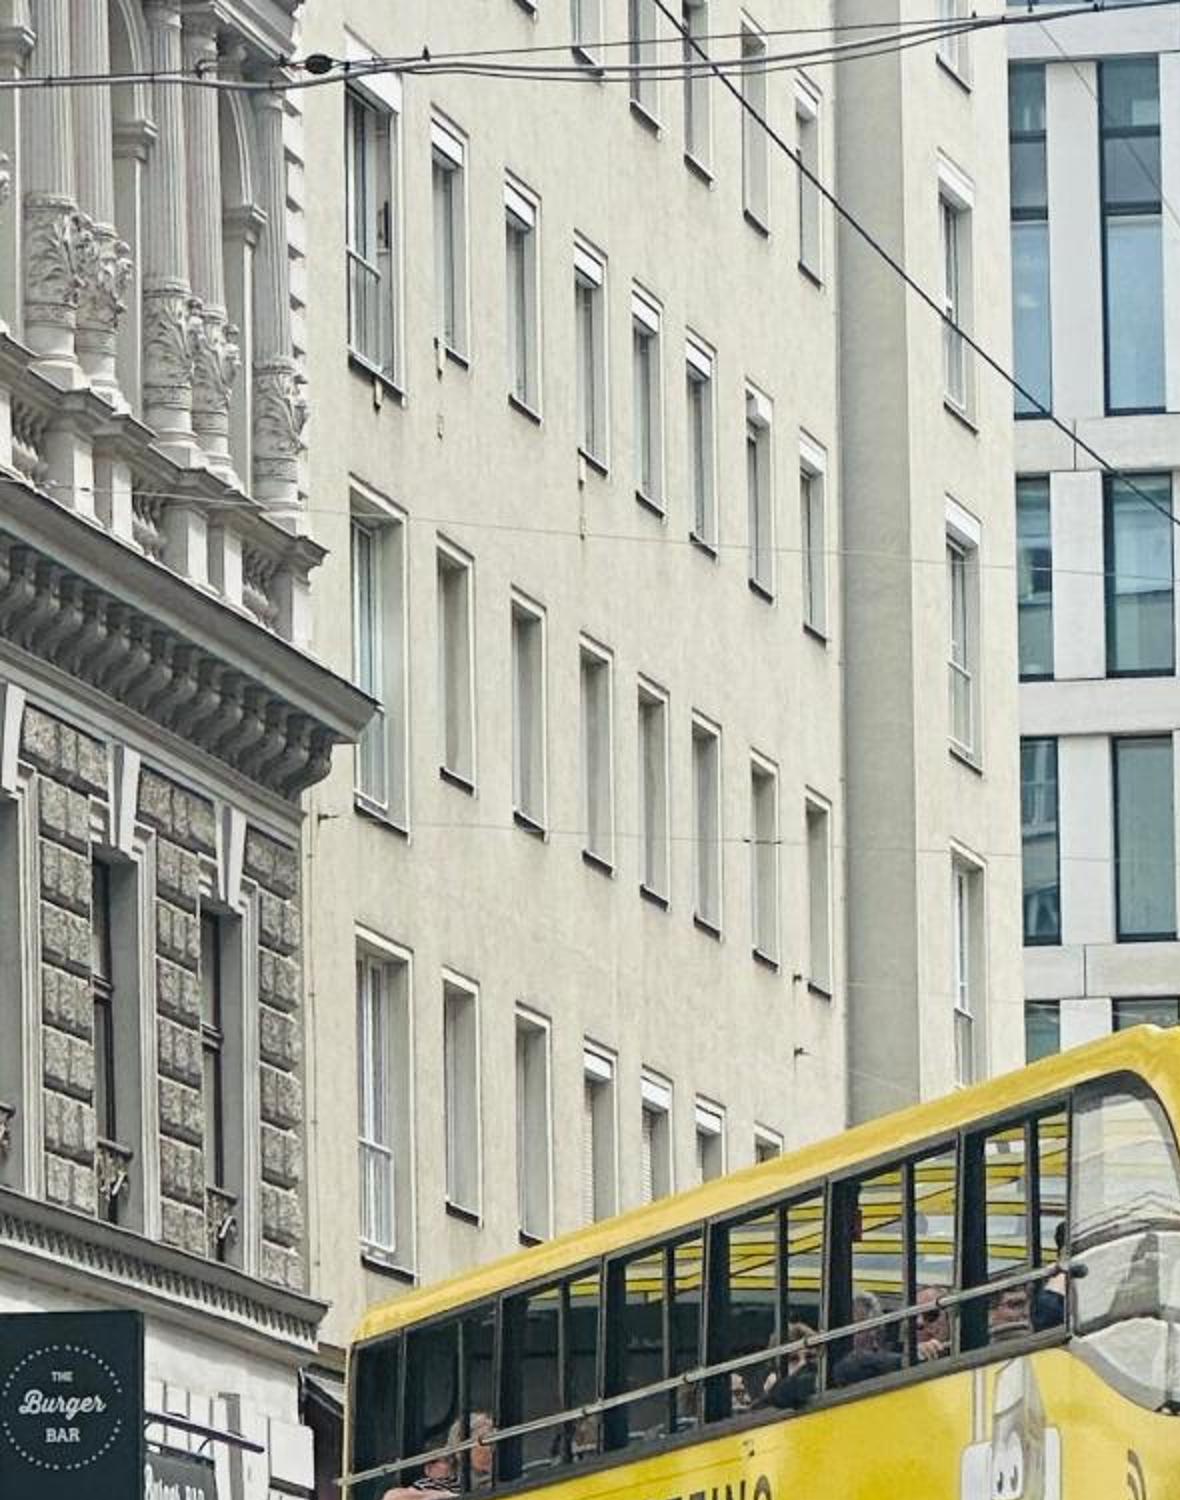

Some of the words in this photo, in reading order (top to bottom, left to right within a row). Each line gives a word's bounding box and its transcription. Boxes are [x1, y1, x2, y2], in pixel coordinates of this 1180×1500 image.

[51, 1371, 73, 1382] THE
[18, 1389, 107, 1421] Burger
[45, 1427, 81, 1443] BAR
